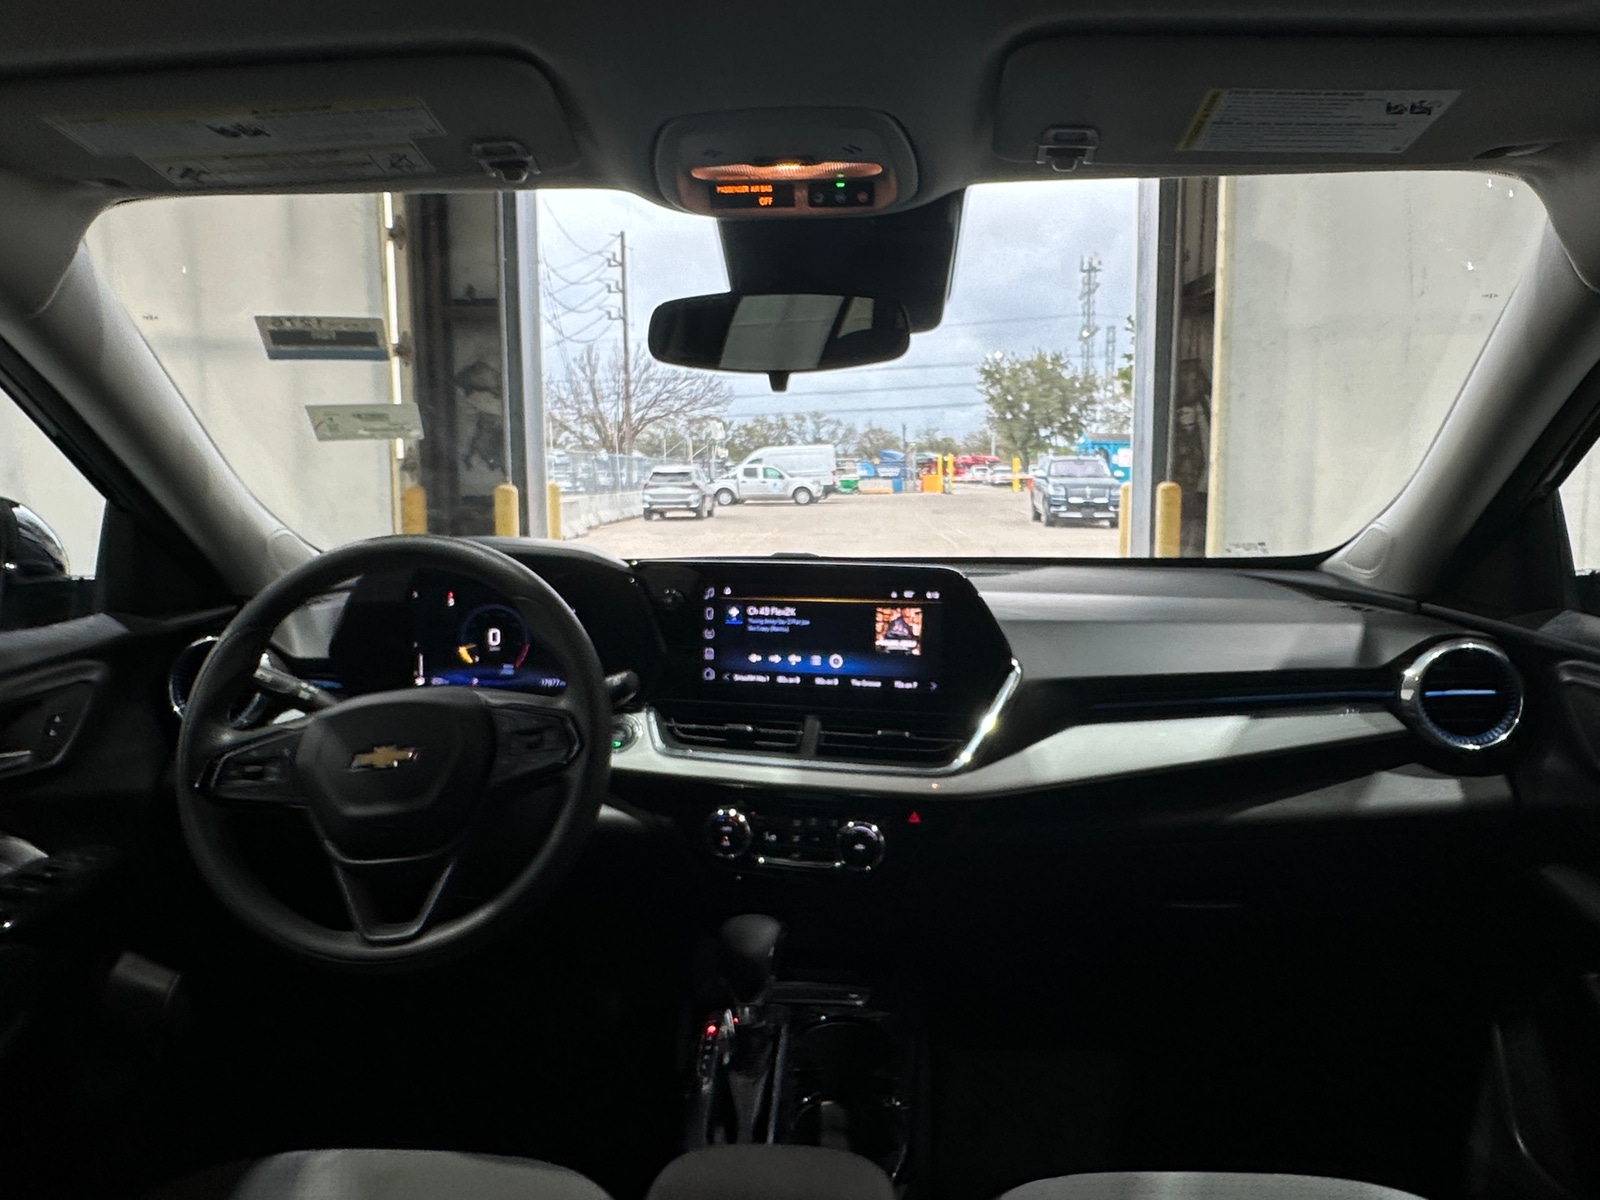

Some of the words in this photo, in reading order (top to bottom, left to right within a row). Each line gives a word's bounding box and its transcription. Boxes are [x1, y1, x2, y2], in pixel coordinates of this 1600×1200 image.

[716, 185, 749, 194] PASSENGER
[760, 184, 773, 193] BAG
[758, 196, 773, 206] OFF
[488, 627, 501, 646] 0
